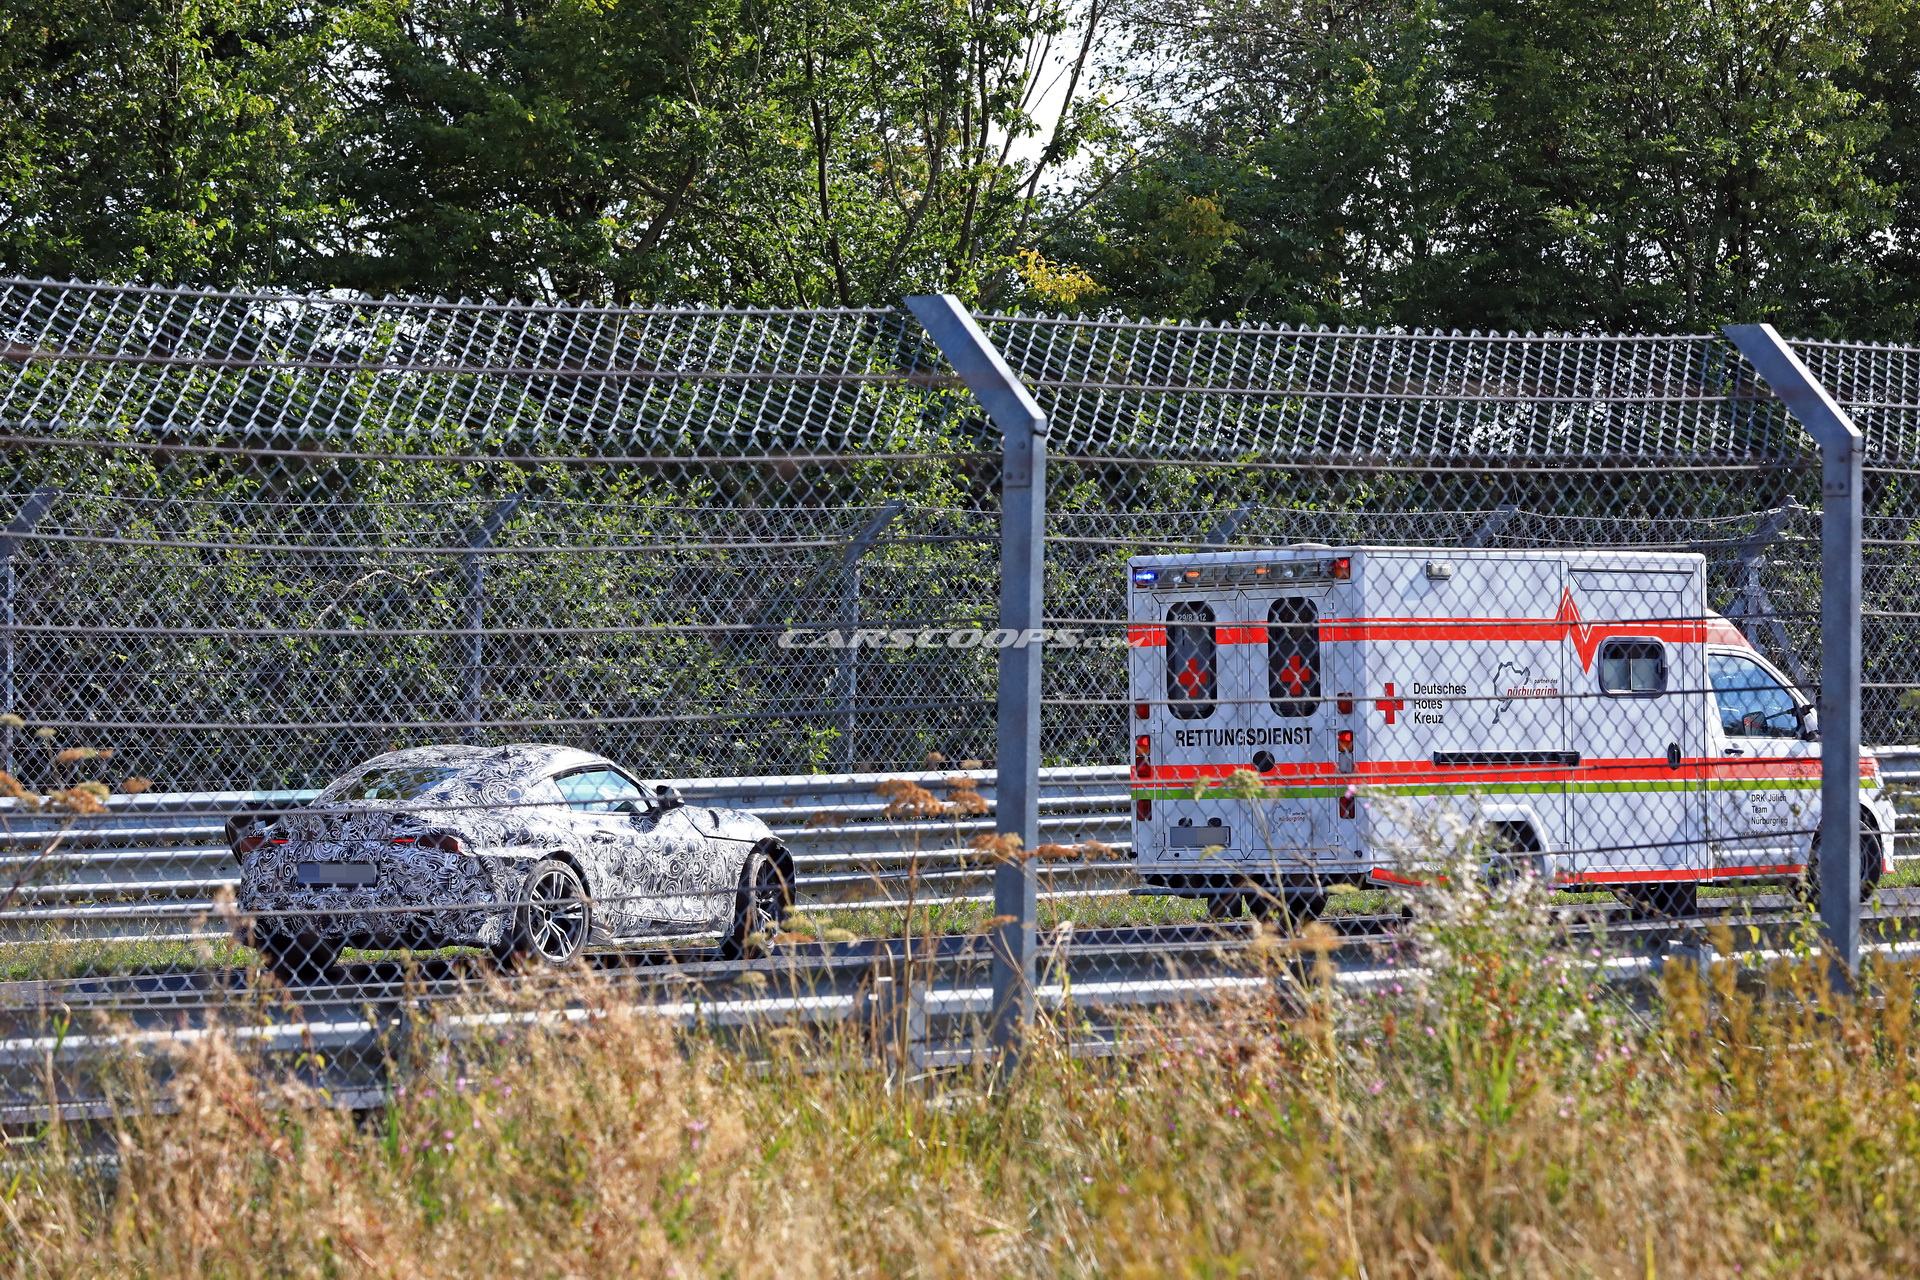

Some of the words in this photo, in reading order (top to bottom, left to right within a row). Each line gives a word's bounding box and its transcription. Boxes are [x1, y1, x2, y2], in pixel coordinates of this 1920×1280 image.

[1413, 682, 1467, 695] Deutsches
[1413, 699, 1443, 710] Rotes
[1414, 711, 1444, 724] Kreuz
[1175, 727, 1313, 747] RETTUNGSDIENST
[1751, 793, 1765, 802] DRK
[1767, 793, 1787, 802] Jülich
[1751, 805, 1768, 814] Team
[1751, 816, 1789, 826] Nürburgring
